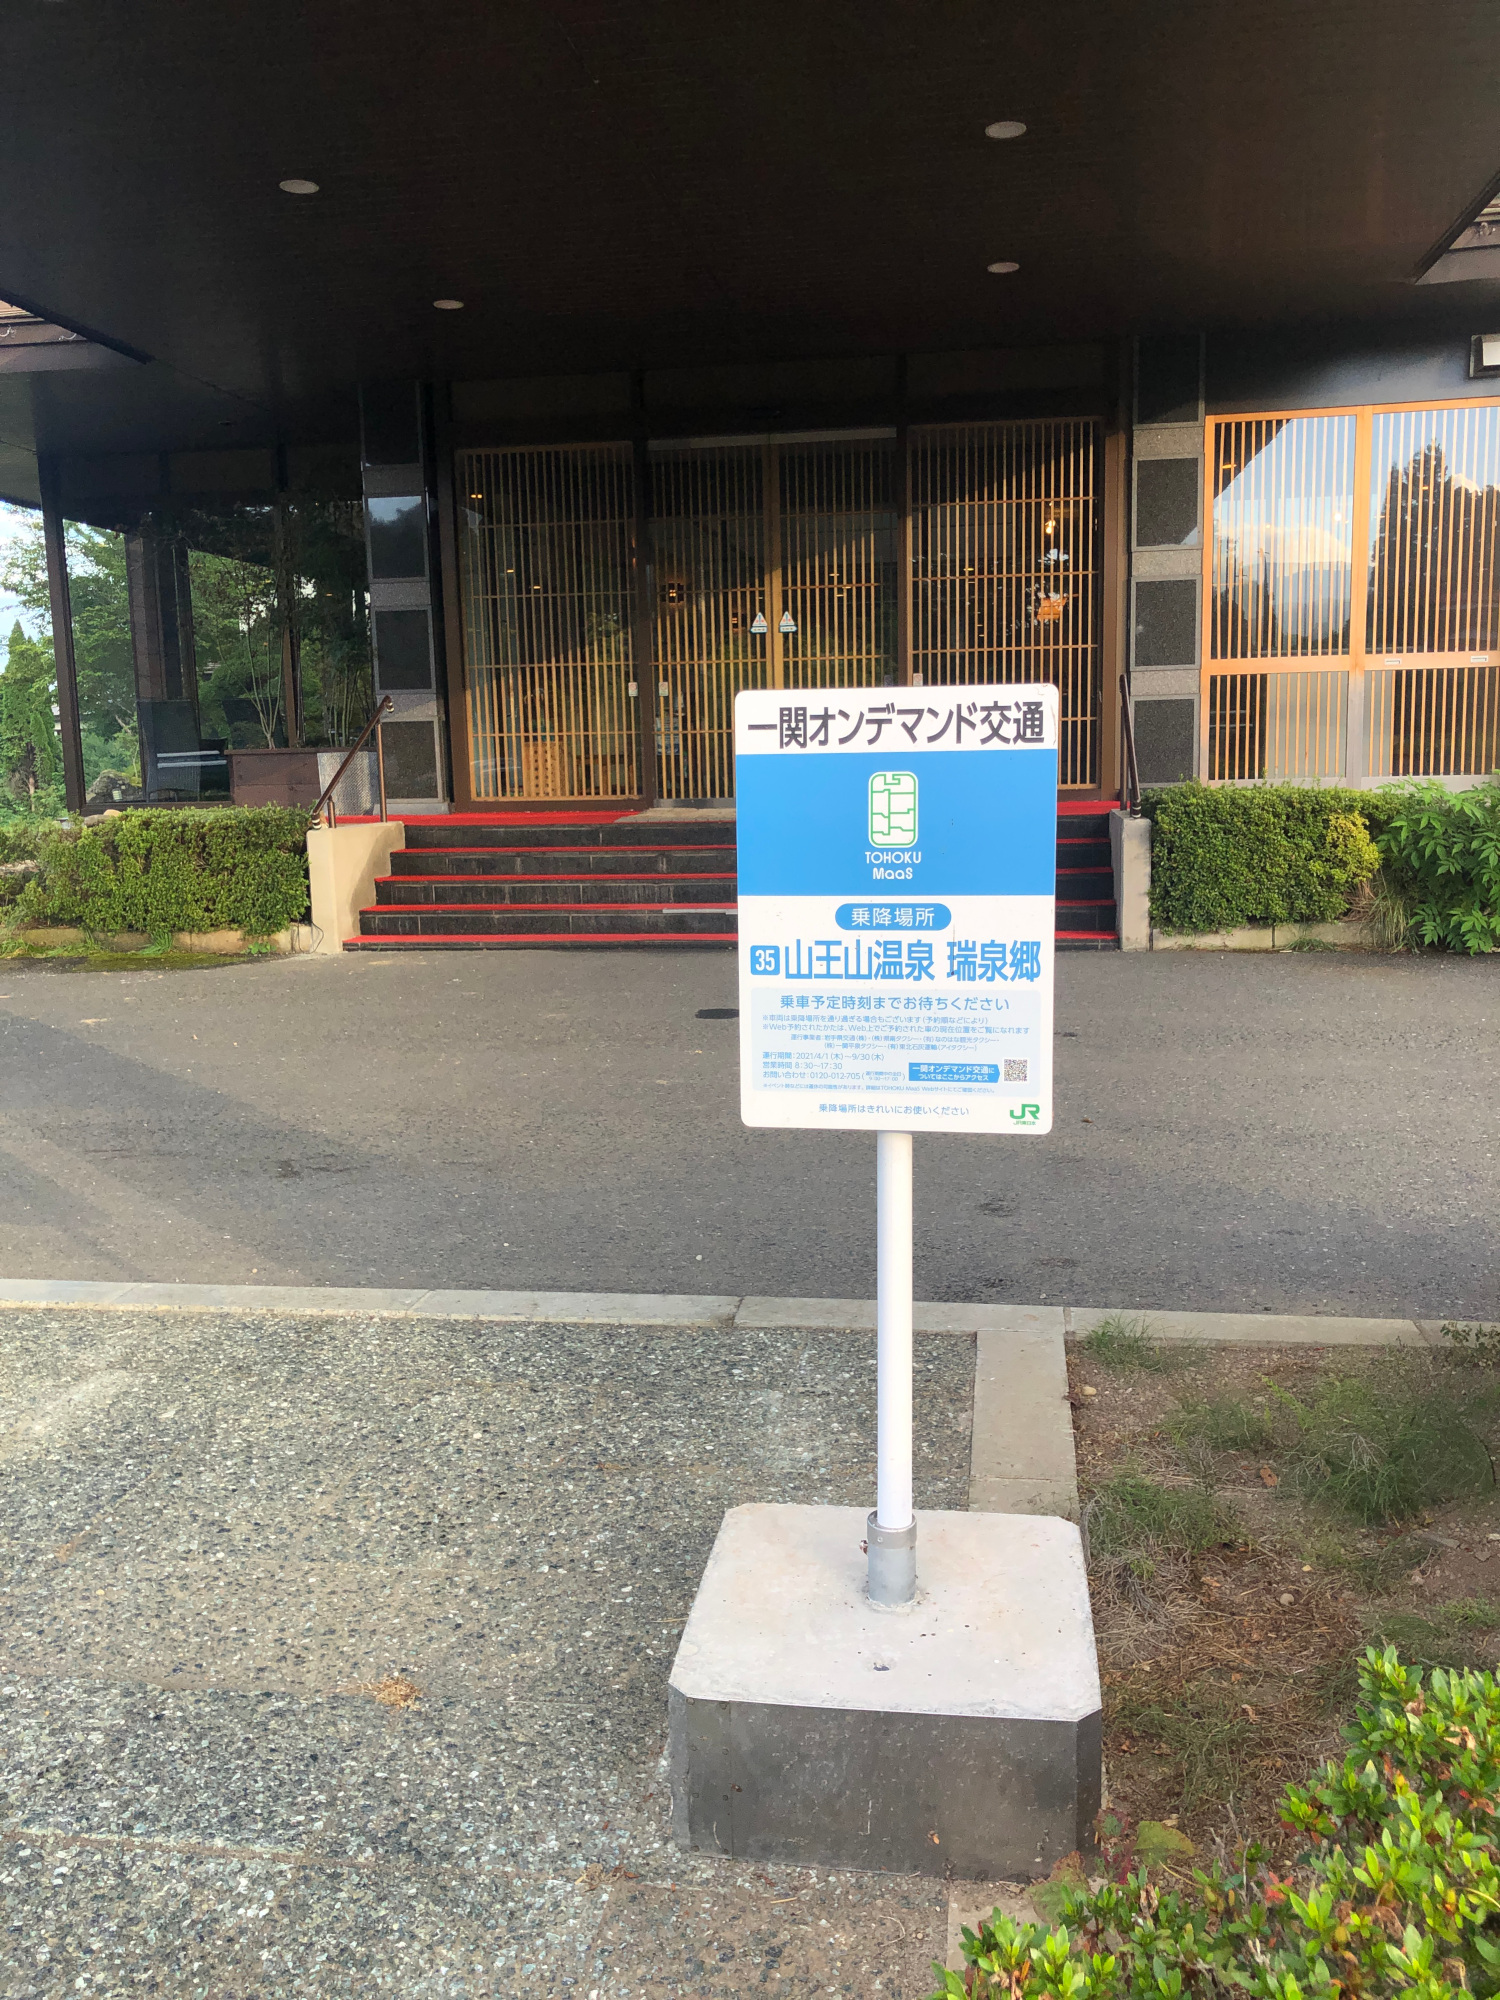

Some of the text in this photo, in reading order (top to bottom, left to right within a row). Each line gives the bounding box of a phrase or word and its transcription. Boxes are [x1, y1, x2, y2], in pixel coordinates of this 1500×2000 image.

[748, 700, 1045, 750] 一関オンデマンド交通
[865, 851, 922, 864] TOHOKU
[872, 867, 913, 880] MaaS
[851, 907, 935, 927] 乗降場所
[755, 939, 1041, 982] 35 山王山温泉 瑞泉郷
[780, 995, 1010, 1012] 乗車予定時刻までお待ちください
[918, 1073, 989, 1081] ついてはここからアクセス
[818, 1103, 969, 1116] 乗降場所はきれいにお使いください
[1010, 1104, 1040, 1119] JR
